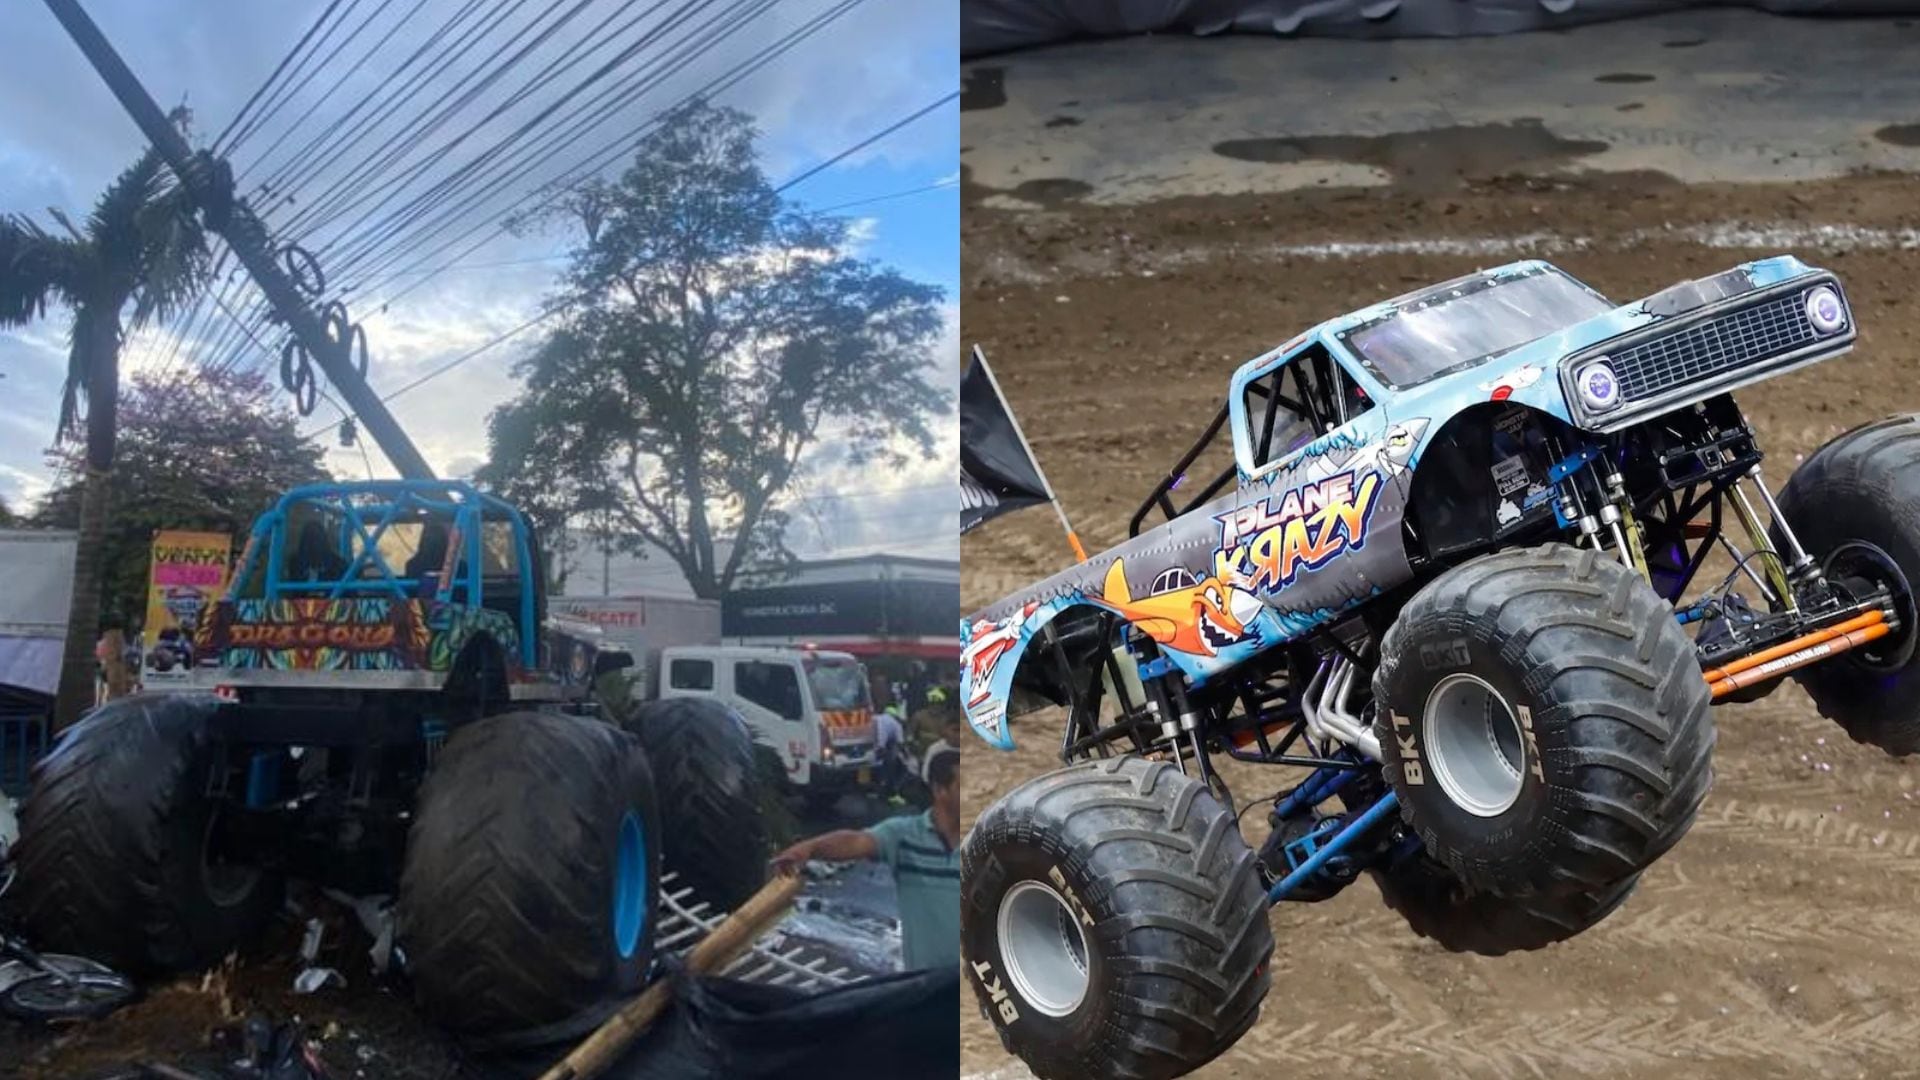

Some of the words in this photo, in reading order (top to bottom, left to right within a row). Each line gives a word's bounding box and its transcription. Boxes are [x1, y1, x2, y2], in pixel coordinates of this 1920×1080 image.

[1215, 470, 1356, 548] PLANE
[1418, 639, 1472, 671] BKT
[1389, 708, 1425, 787] BKT
[1516, 705, 1546, 784] BKT
[1048, 865, 1096, 927] BKT
[971, 960, 1020, 1026] BKT
